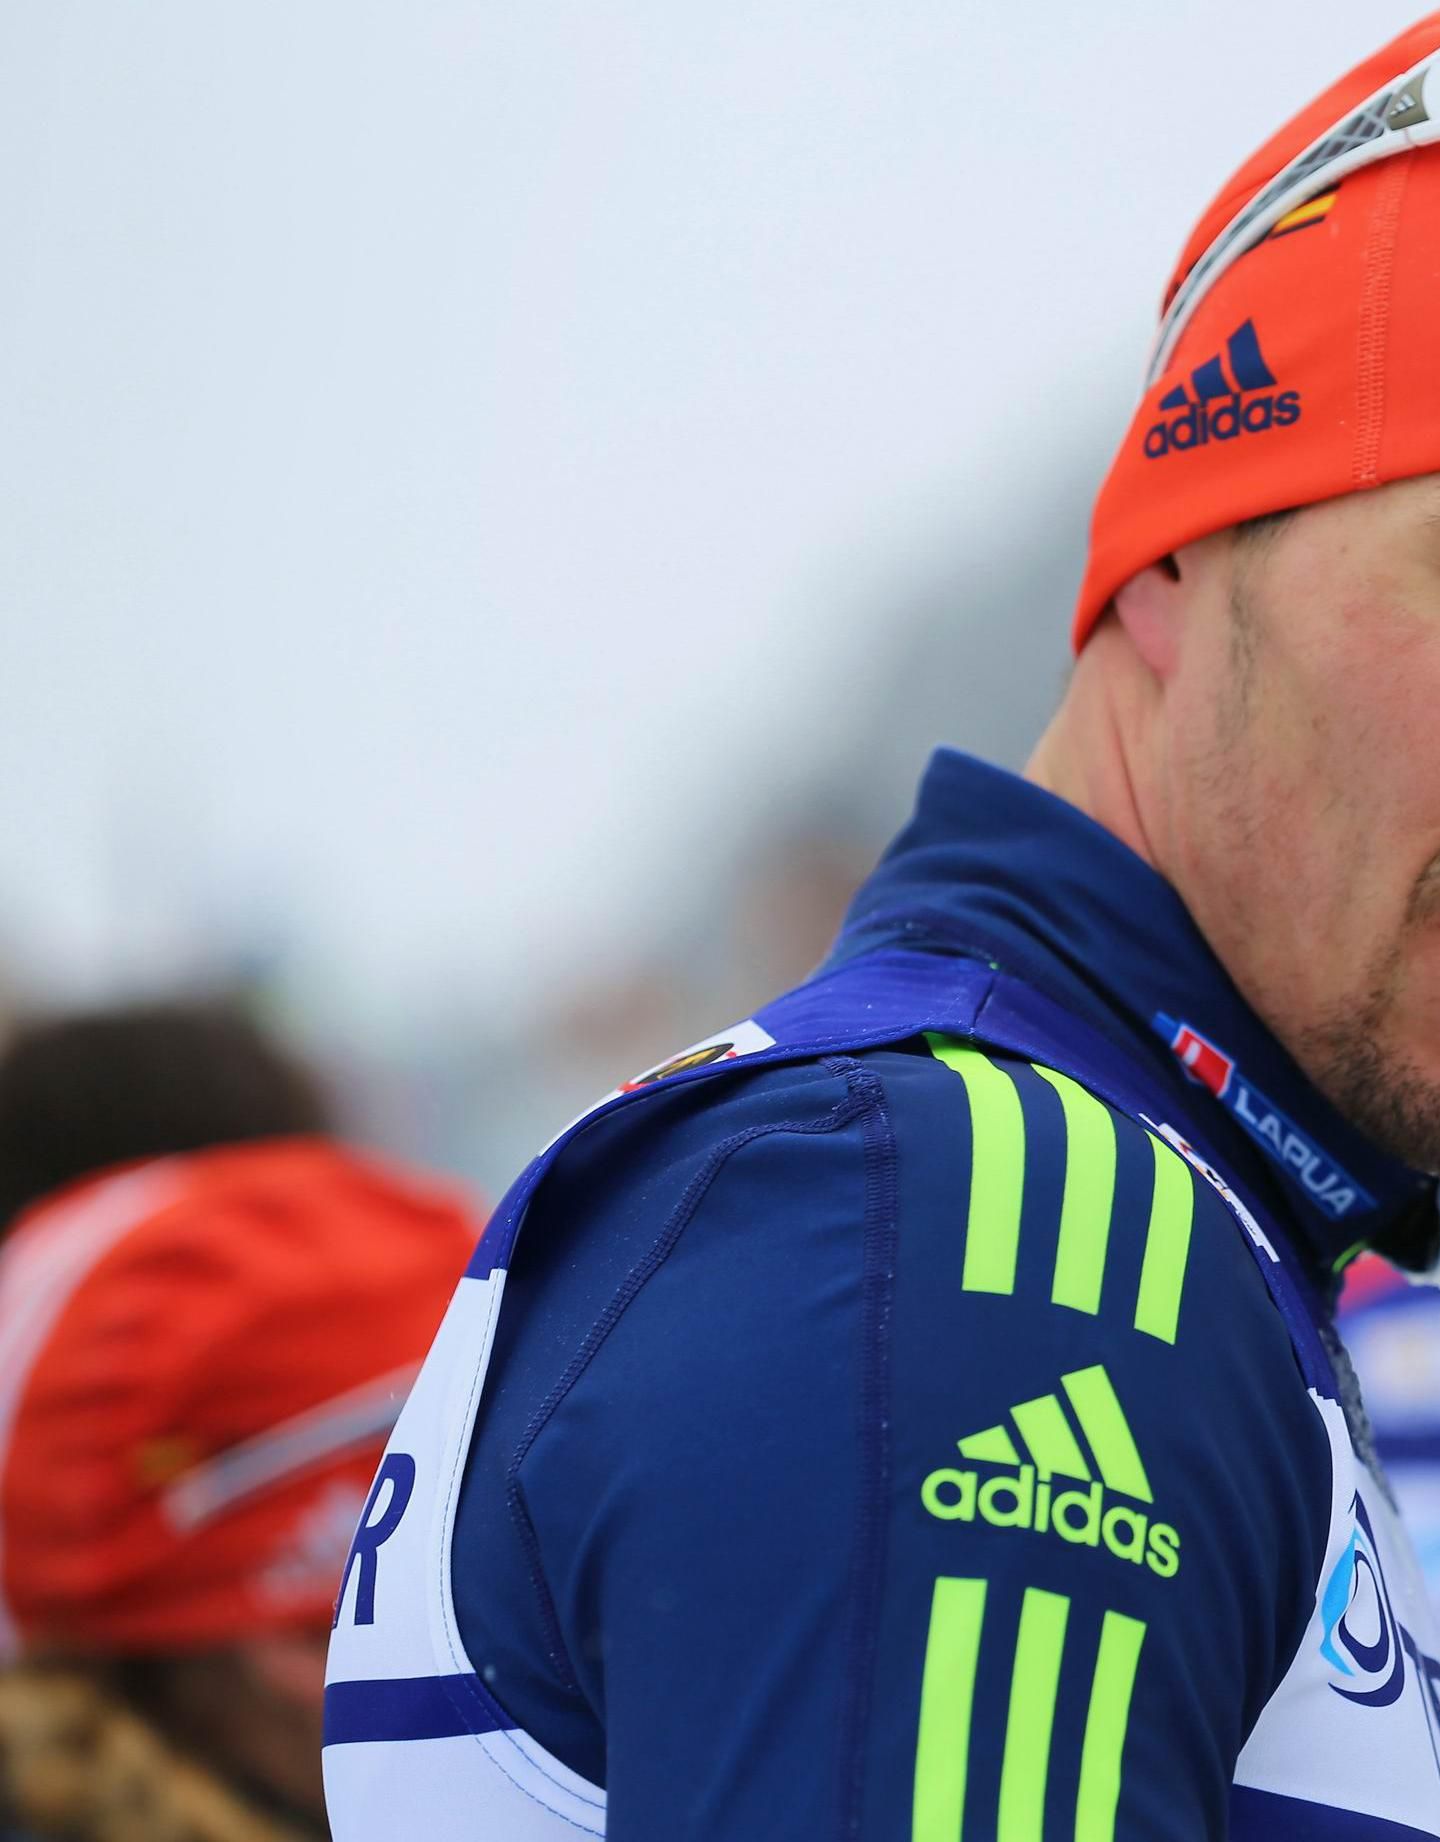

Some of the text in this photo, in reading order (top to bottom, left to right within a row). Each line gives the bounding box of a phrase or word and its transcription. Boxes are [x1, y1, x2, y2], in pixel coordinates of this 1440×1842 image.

[1143, 390, 1301, 459] adidas
[1233, 1087, 1357, 1215] LAPUA
[921, 1463, 1181, 1578] adidas
